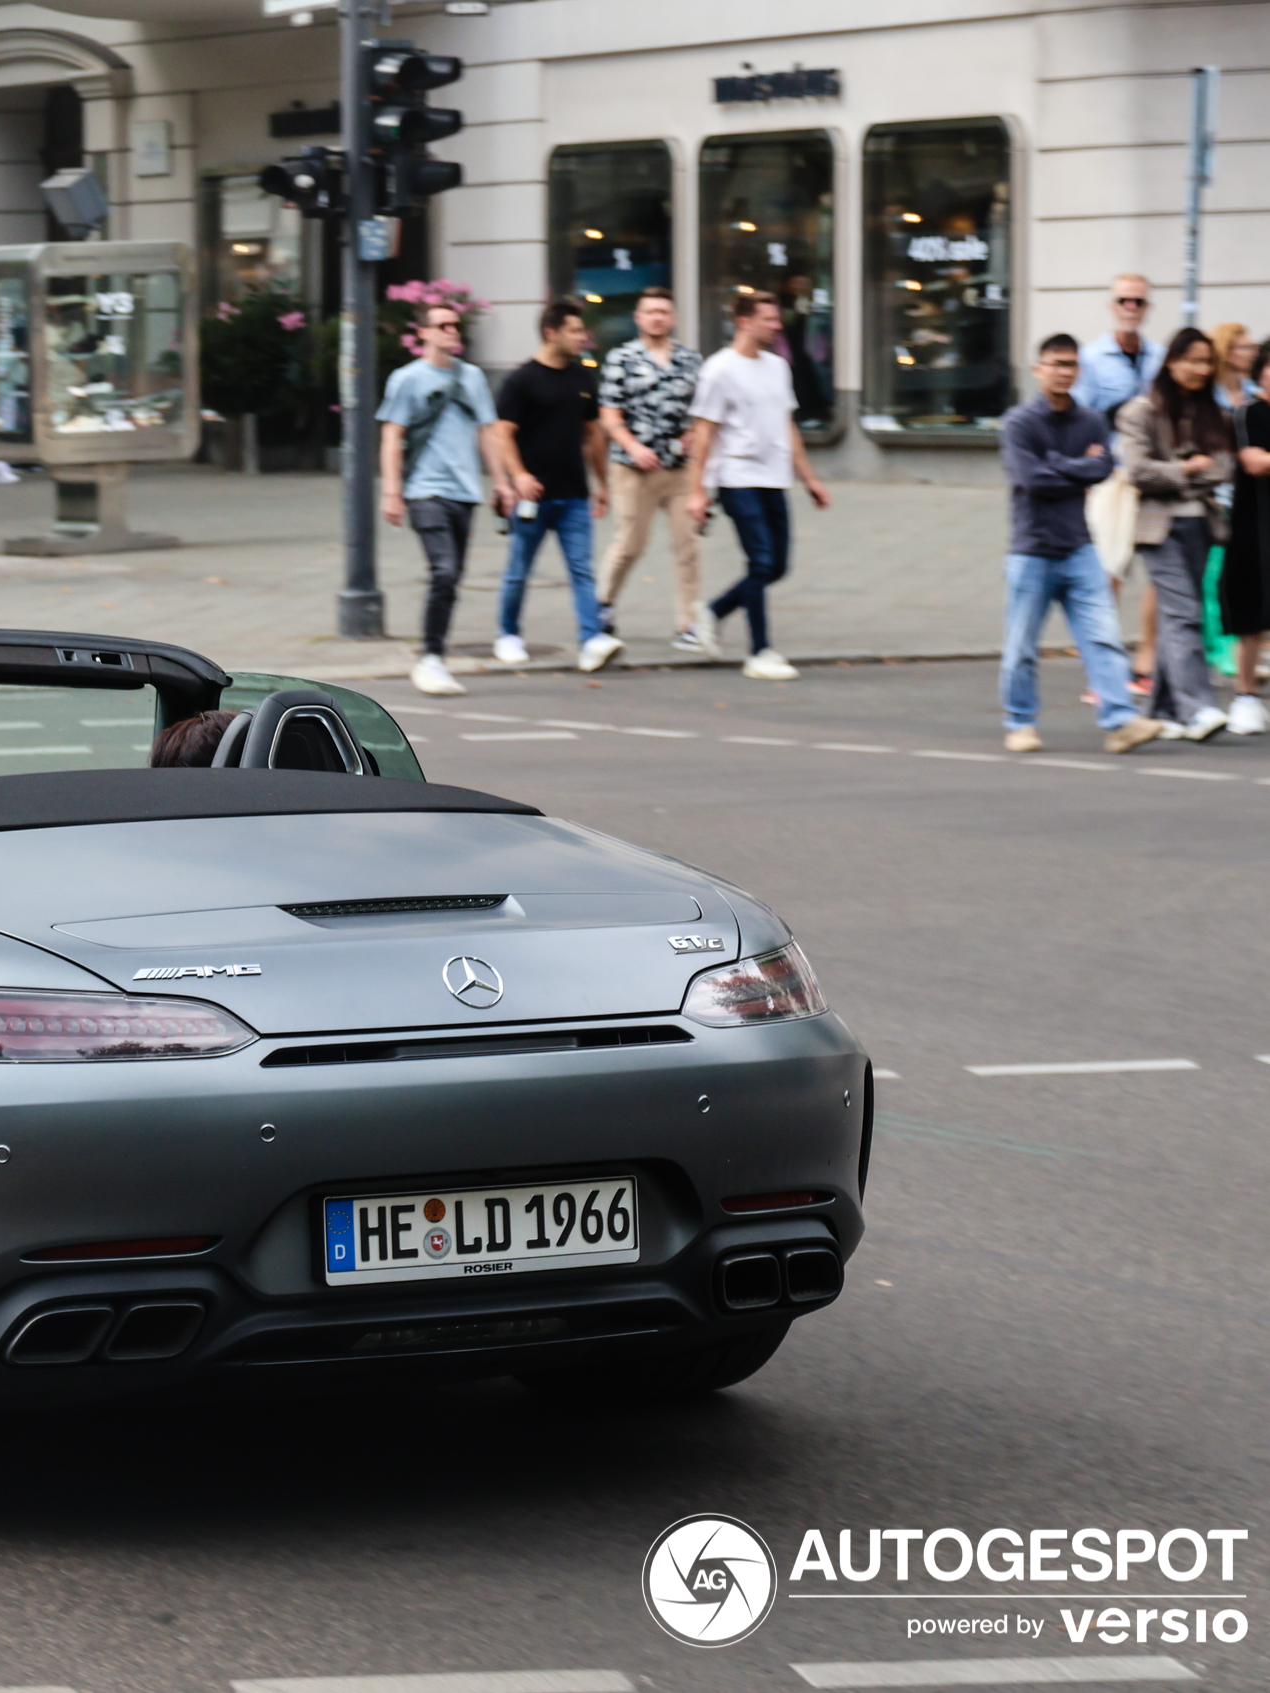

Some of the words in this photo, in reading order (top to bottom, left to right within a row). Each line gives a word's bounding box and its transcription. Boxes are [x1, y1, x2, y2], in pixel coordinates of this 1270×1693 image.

[174, 963, 263, 980] AMG
[334, 1244, 346, 1260] D
[359, 1204, 419, 1262] HE
[454, 1198, 512, 1255] LD
[524, 1187, 630, 1250] 1966
[463, 1262, 513, 1274] ROSIER
